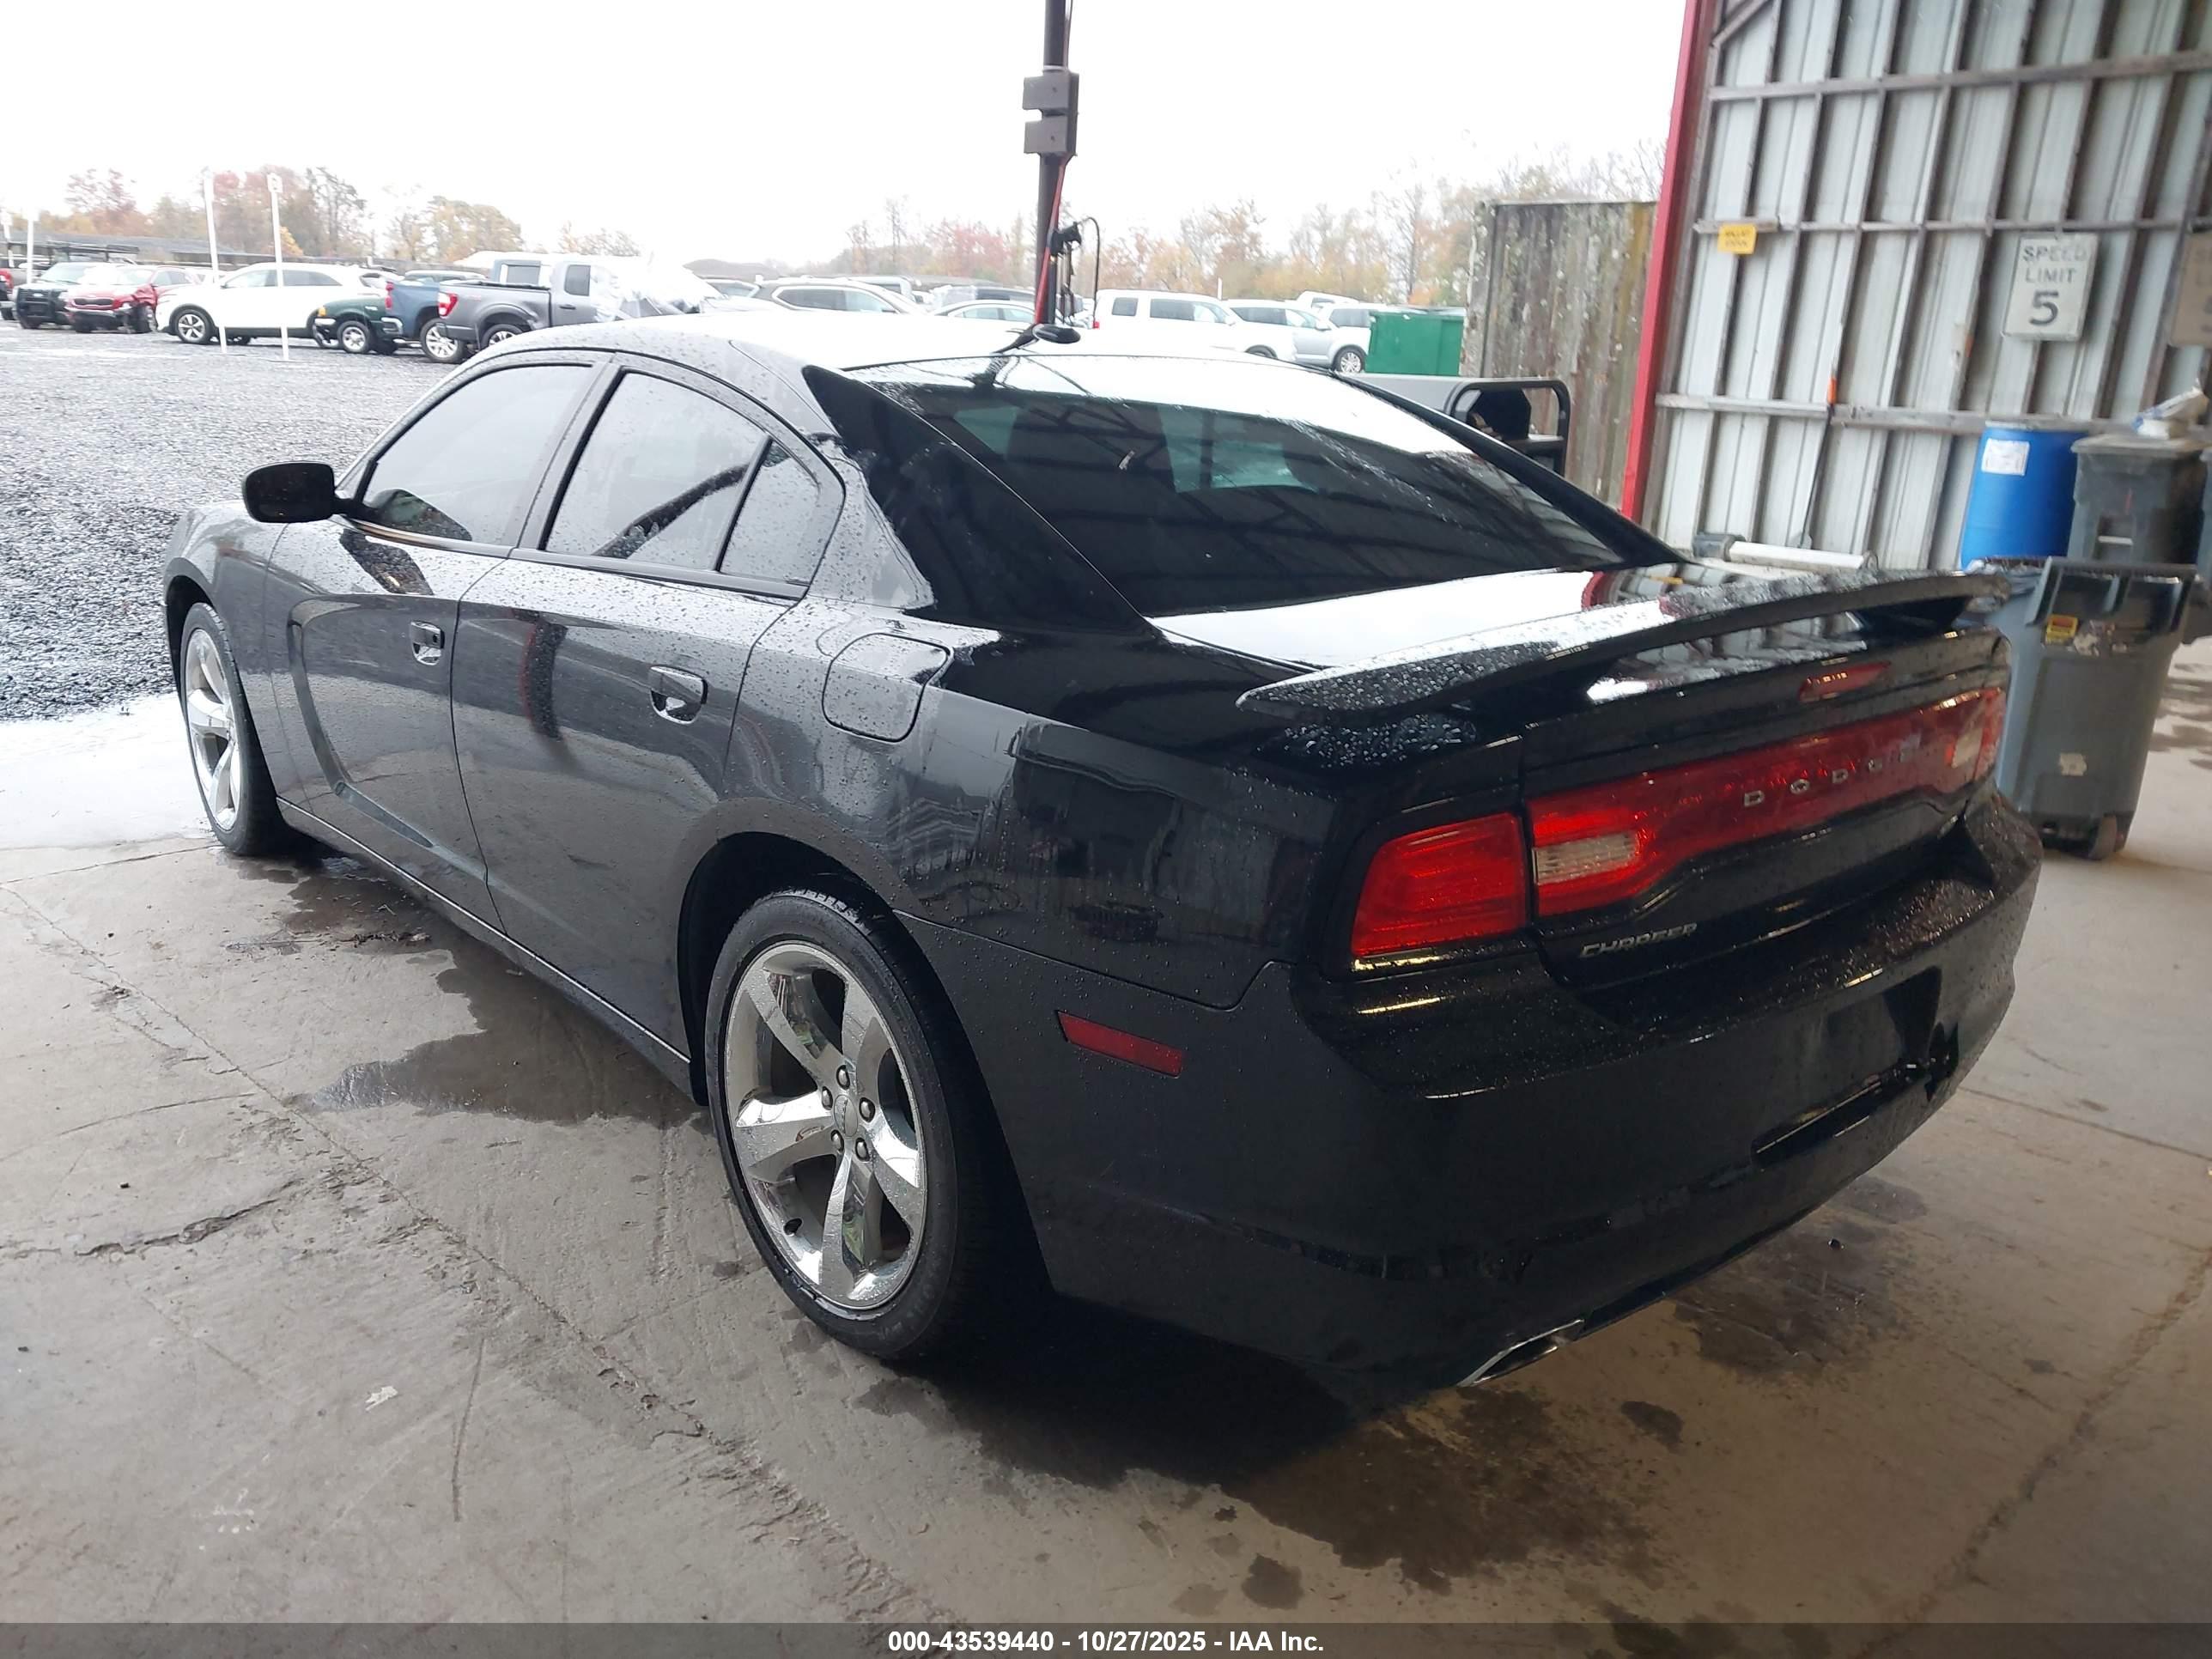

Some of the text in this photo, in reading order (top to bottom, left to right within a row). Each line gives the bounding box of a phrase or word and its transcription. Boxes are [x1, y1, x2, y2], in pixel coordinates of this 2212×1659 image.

[2022, 245, 2087, 262] SPEED
[2025, 266, 2075, 283] LIMIT
[2029, 290, 2060, 326] 5
